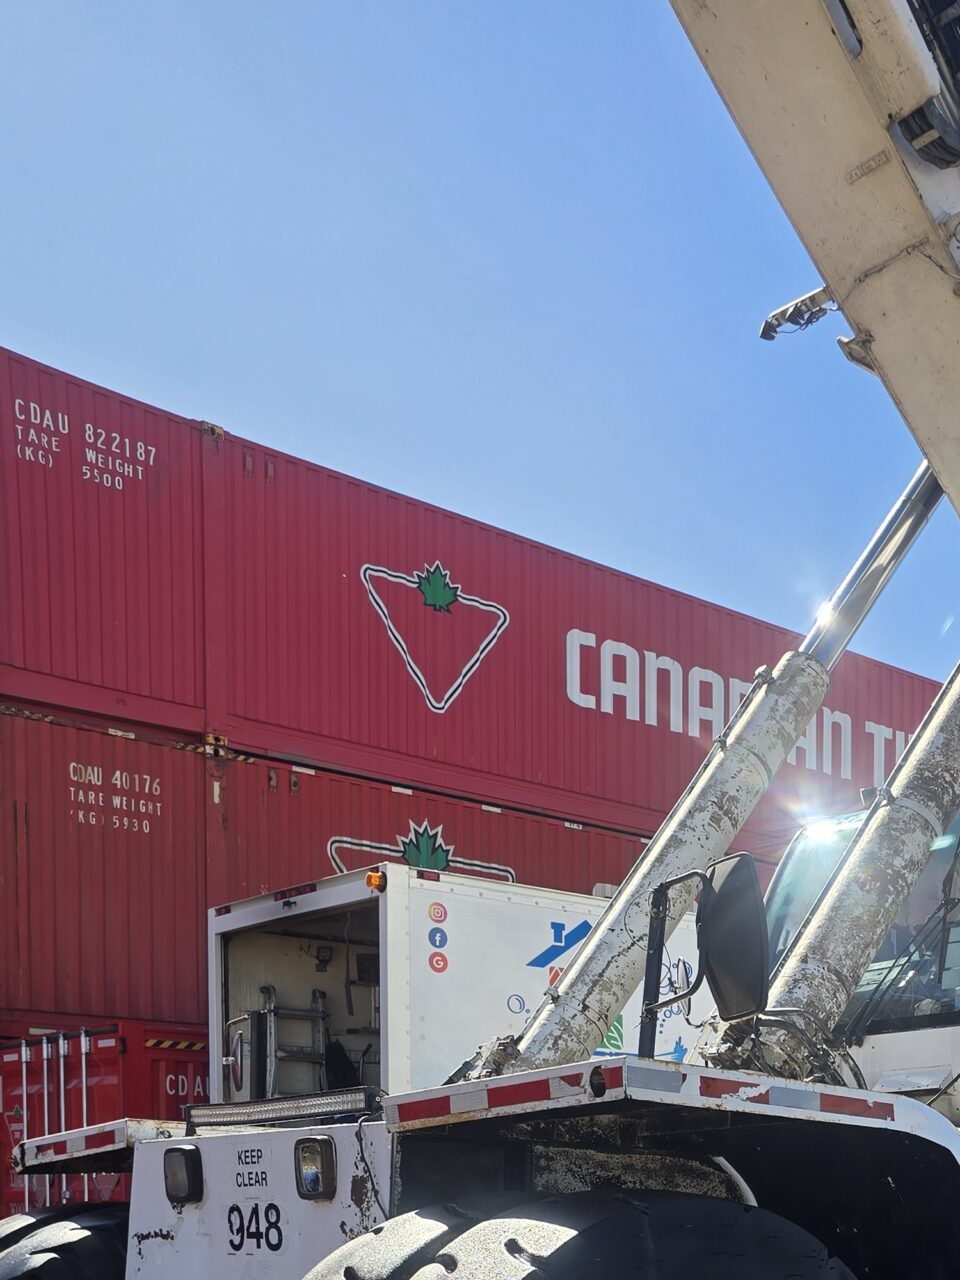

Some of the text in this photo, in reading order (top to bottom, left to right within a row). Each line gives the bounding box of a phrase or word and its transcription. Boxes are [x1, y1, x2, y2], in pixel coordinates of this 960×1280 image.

[15, 399, 156, 466] CDAU 822187
[15, 425, 144, 480] TARE WEIGHT
[17, 444, 123, 490] (KG) 5500
[566, 628, 852, 780] CANAAN
[69, 762, 161, 795] CDAU 40176
[69, 787, 161, 816] TARE WEIGHT
[112, 815, 150, 833] 5930
[237, 1149, 263, 1166] KEEP
[236, 1171, 268, 1188] CLEAR
[228, 1203, 283, 1252] 948
